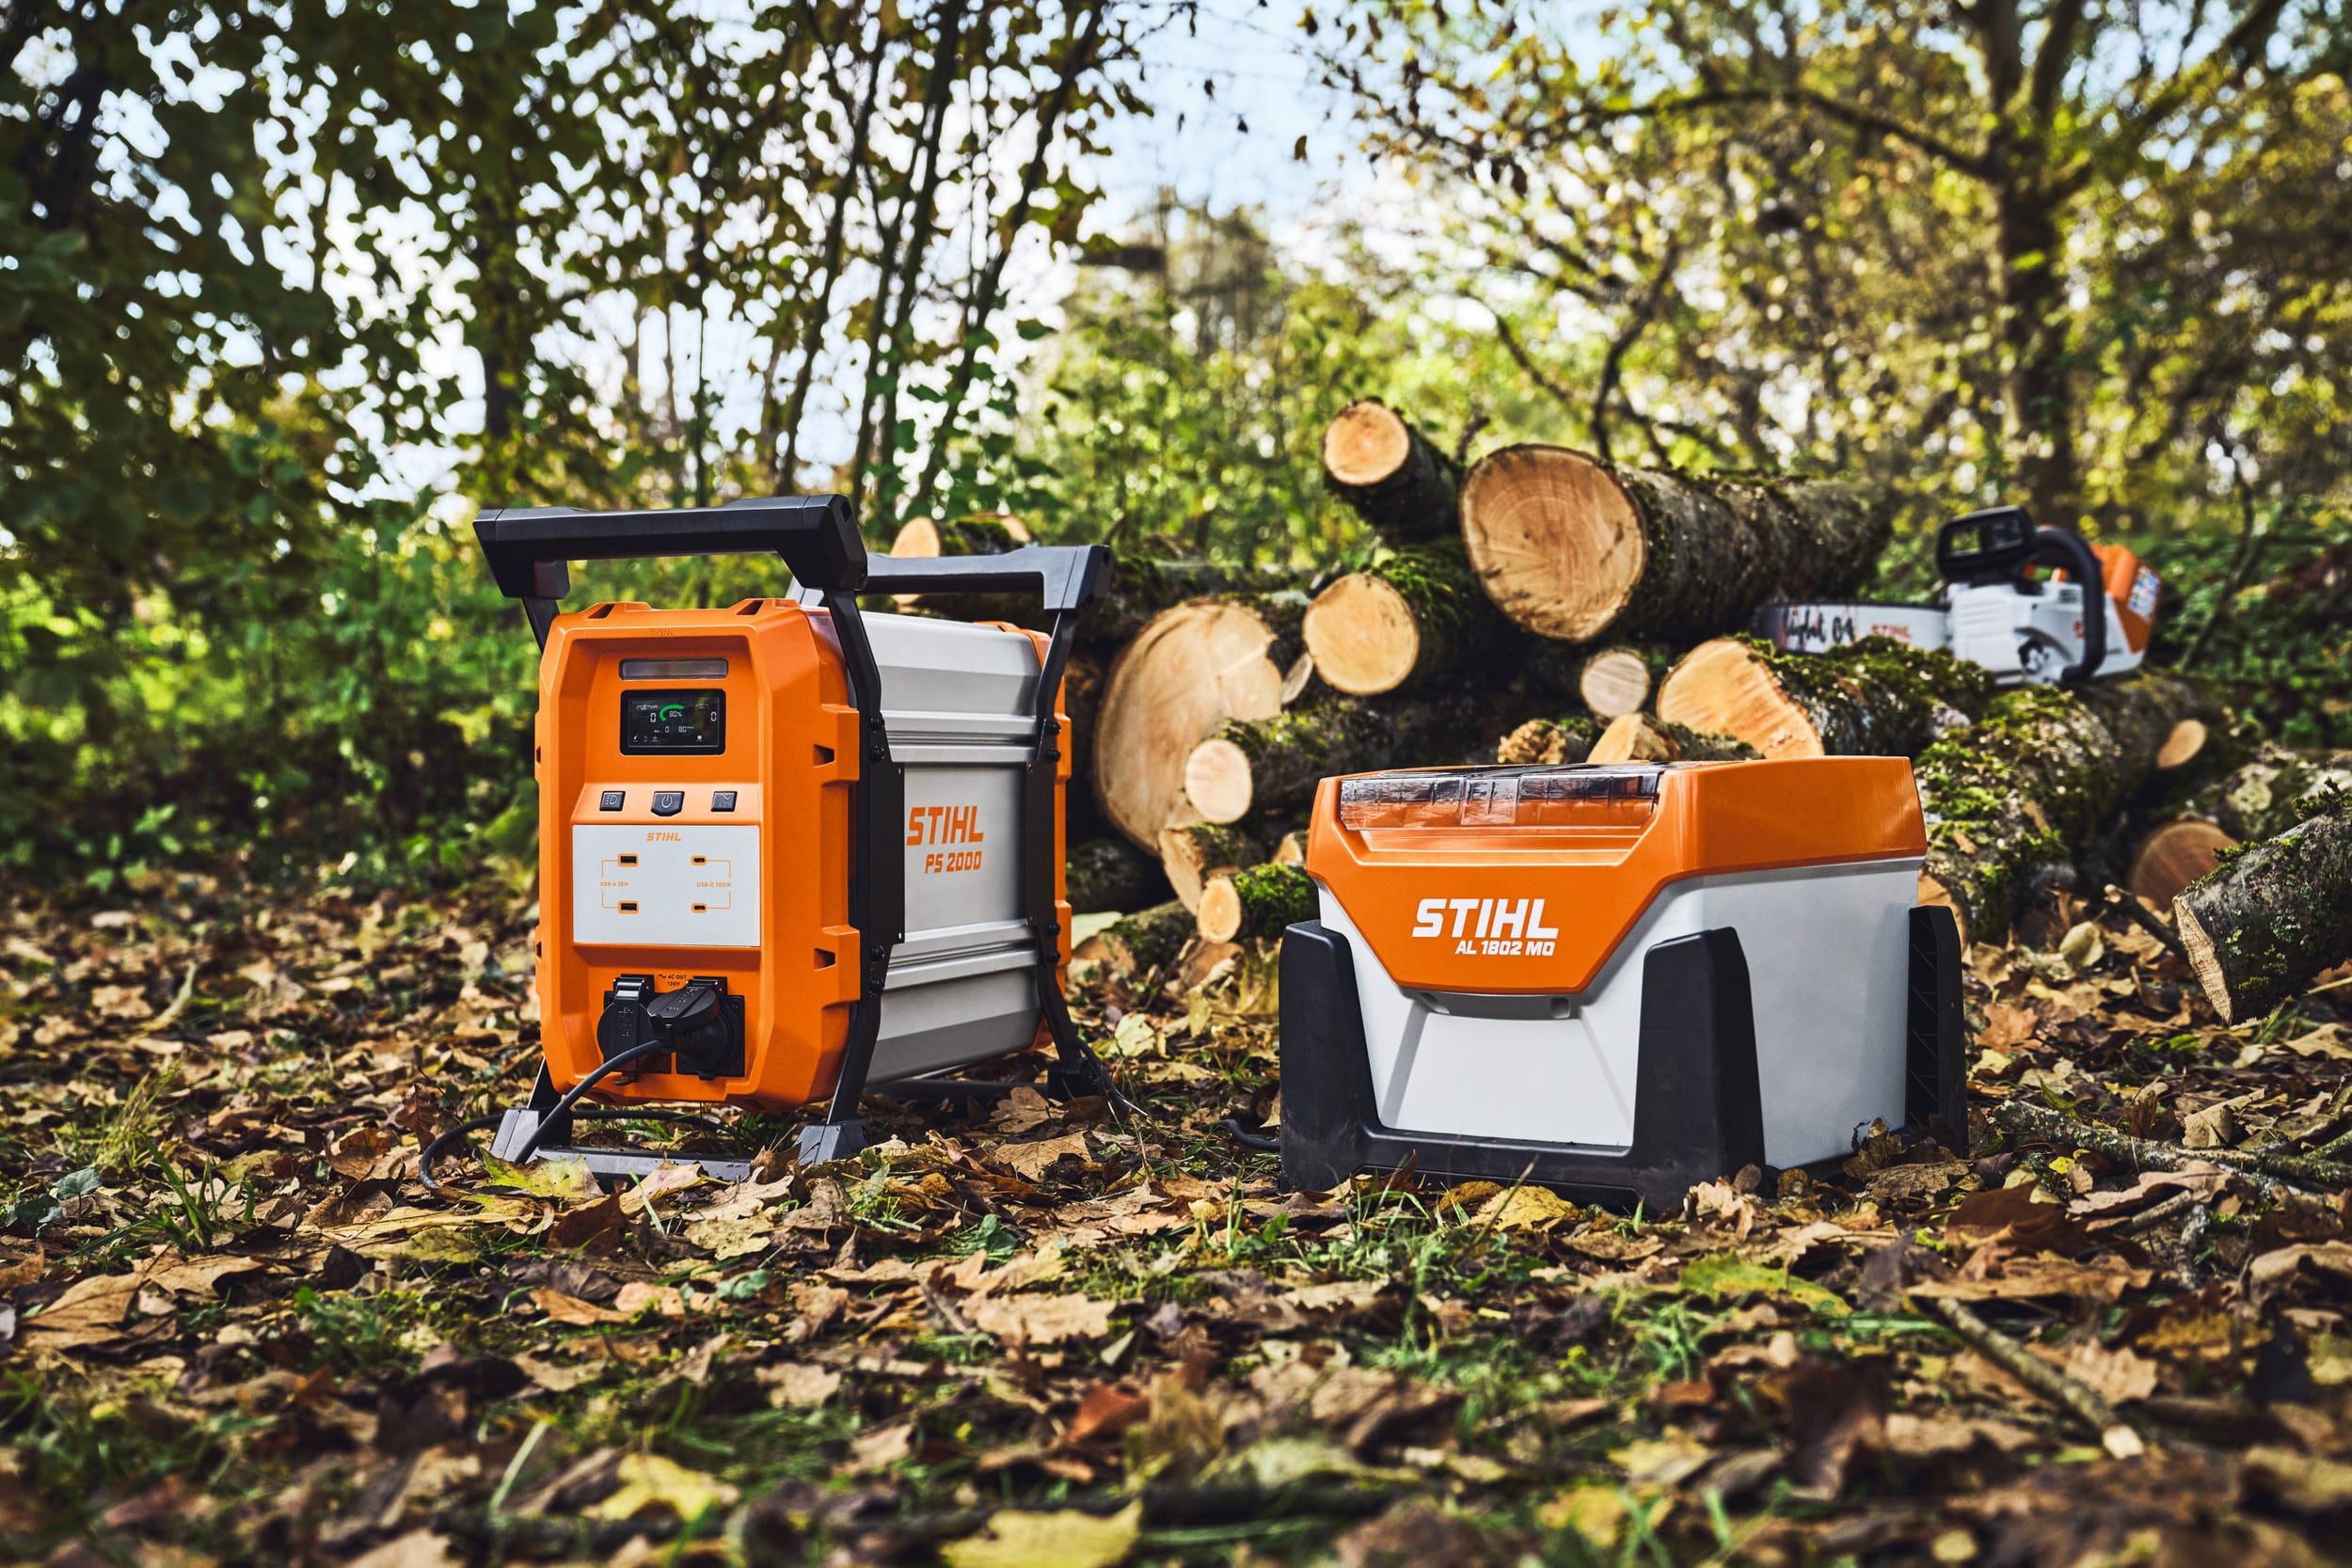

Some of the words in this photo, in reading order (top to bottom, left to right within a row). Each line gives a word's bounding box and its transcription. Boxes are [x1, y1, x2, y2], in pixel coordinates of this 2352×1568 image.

[646, 832, 682, 842] STIHL
[906, 805, 985, 847] STIHL
[924, 852, 944, 874] PS
[946, 850, 982, 873] 2000
[1411, 898, 1559, 940] STIHL
[1454, 940, 1477, 955] AL
[1481, 941, 1523, 956] 1802
[1524, 941, 1556, 957] MO
